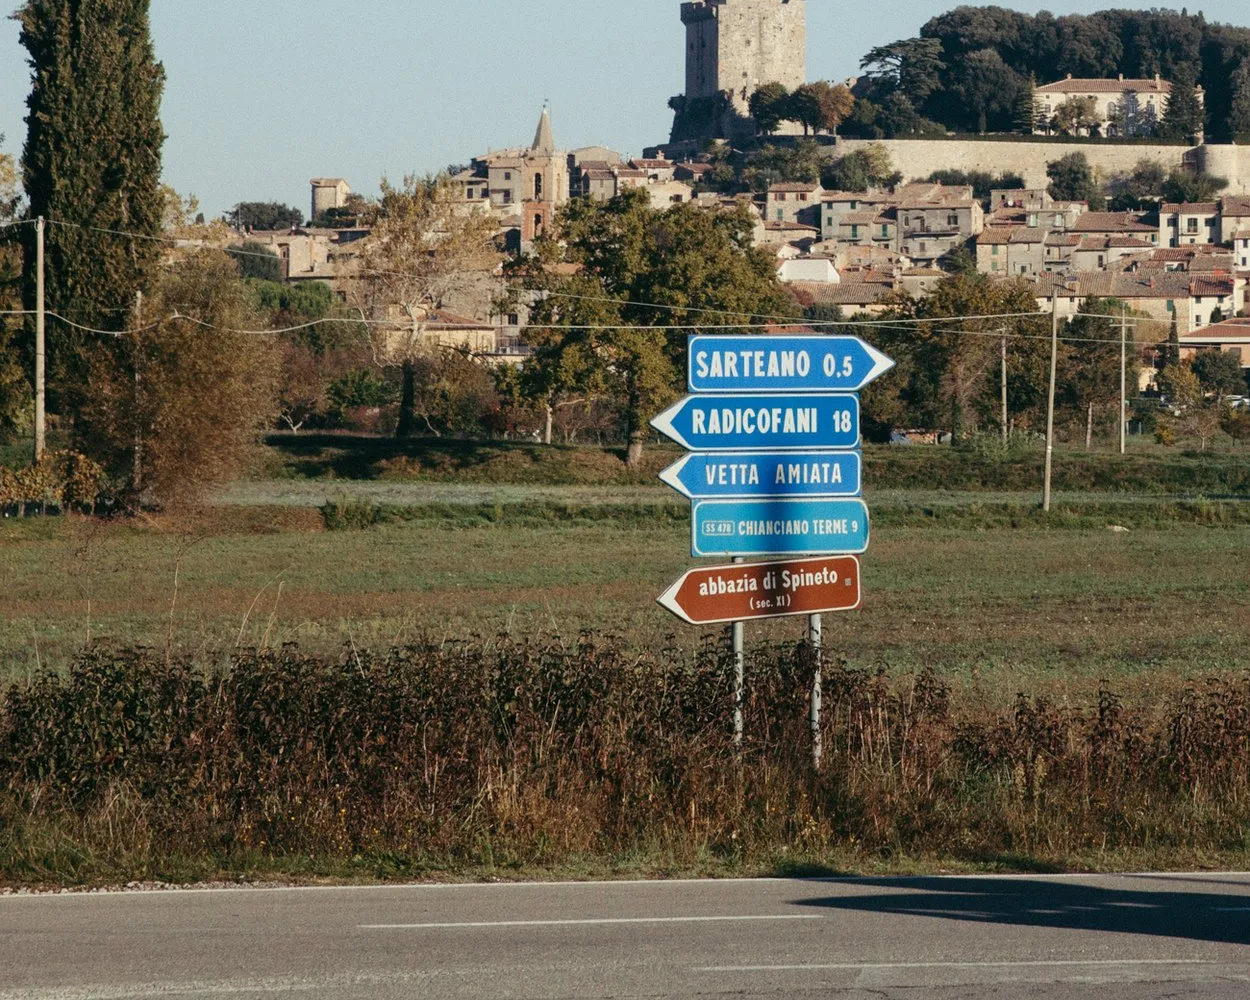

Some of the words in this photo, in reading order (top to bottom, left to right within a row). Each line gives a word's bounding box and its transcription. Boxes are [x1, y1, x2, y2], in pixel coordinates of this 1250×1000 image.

[696, 350, 810, 378] SARTEANO
[692, 408, 817, 434] RADICOFANI
[833, 410, 852, 433] 18
[705, 464, 759, 485] VETTA
[775, 463, 842, 484] AMIATA
[705, 523, 716, 533] SS
[717, 523, 732, 533] 478
[738, 520, 809, 536] CHIANCIANO
[813, 519, 848, 534] TERME
[852, 520, 858, 533] 9
[699, 574, 757, 596] abbazia
[763, 571, 776, 590] di
[782, 567, 838, 591] Spineto
